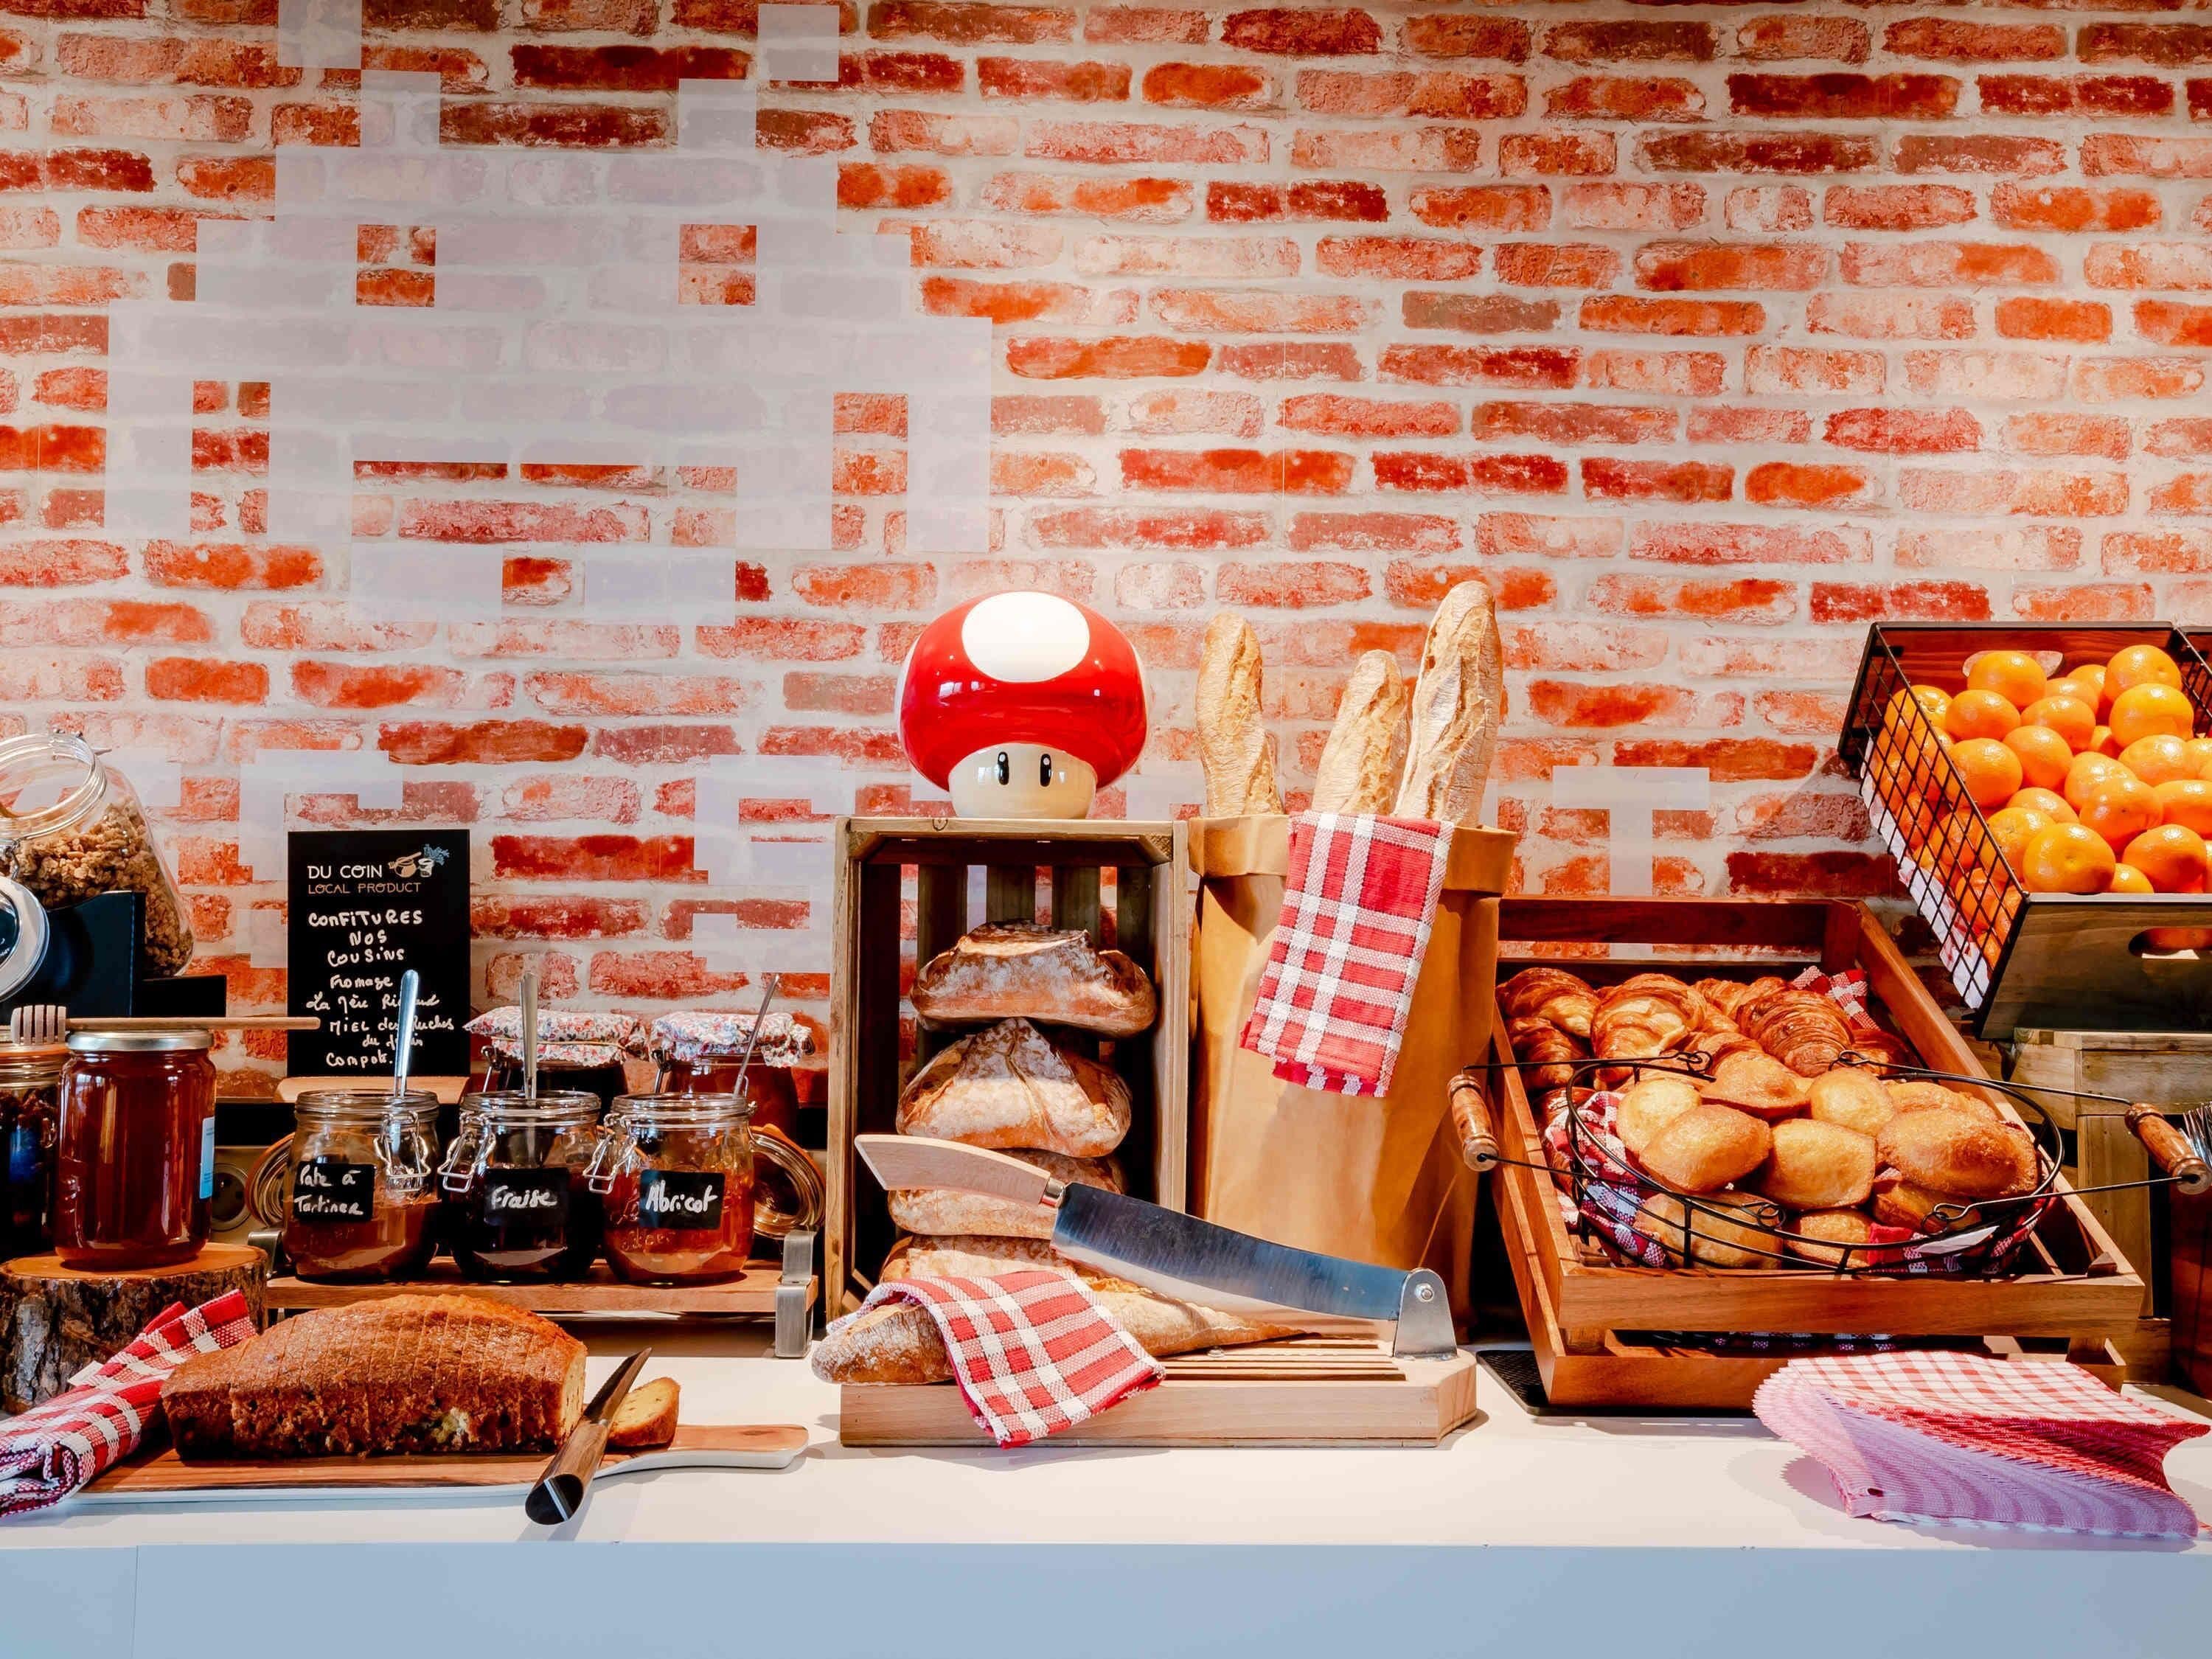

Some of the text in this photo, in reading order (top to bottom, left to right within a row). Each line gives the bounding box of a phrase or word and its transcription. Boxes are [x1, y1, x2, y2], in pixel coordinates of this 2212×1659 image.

[307, 864, 383, 879] DU COIN
[308, 883, 422, 894] LOCAL PRODUCT
[306, 991, 330, 1011] La
[490, 1184, 558, 1210] Fraise
[645, 1179, 718, 1214] Abricot
